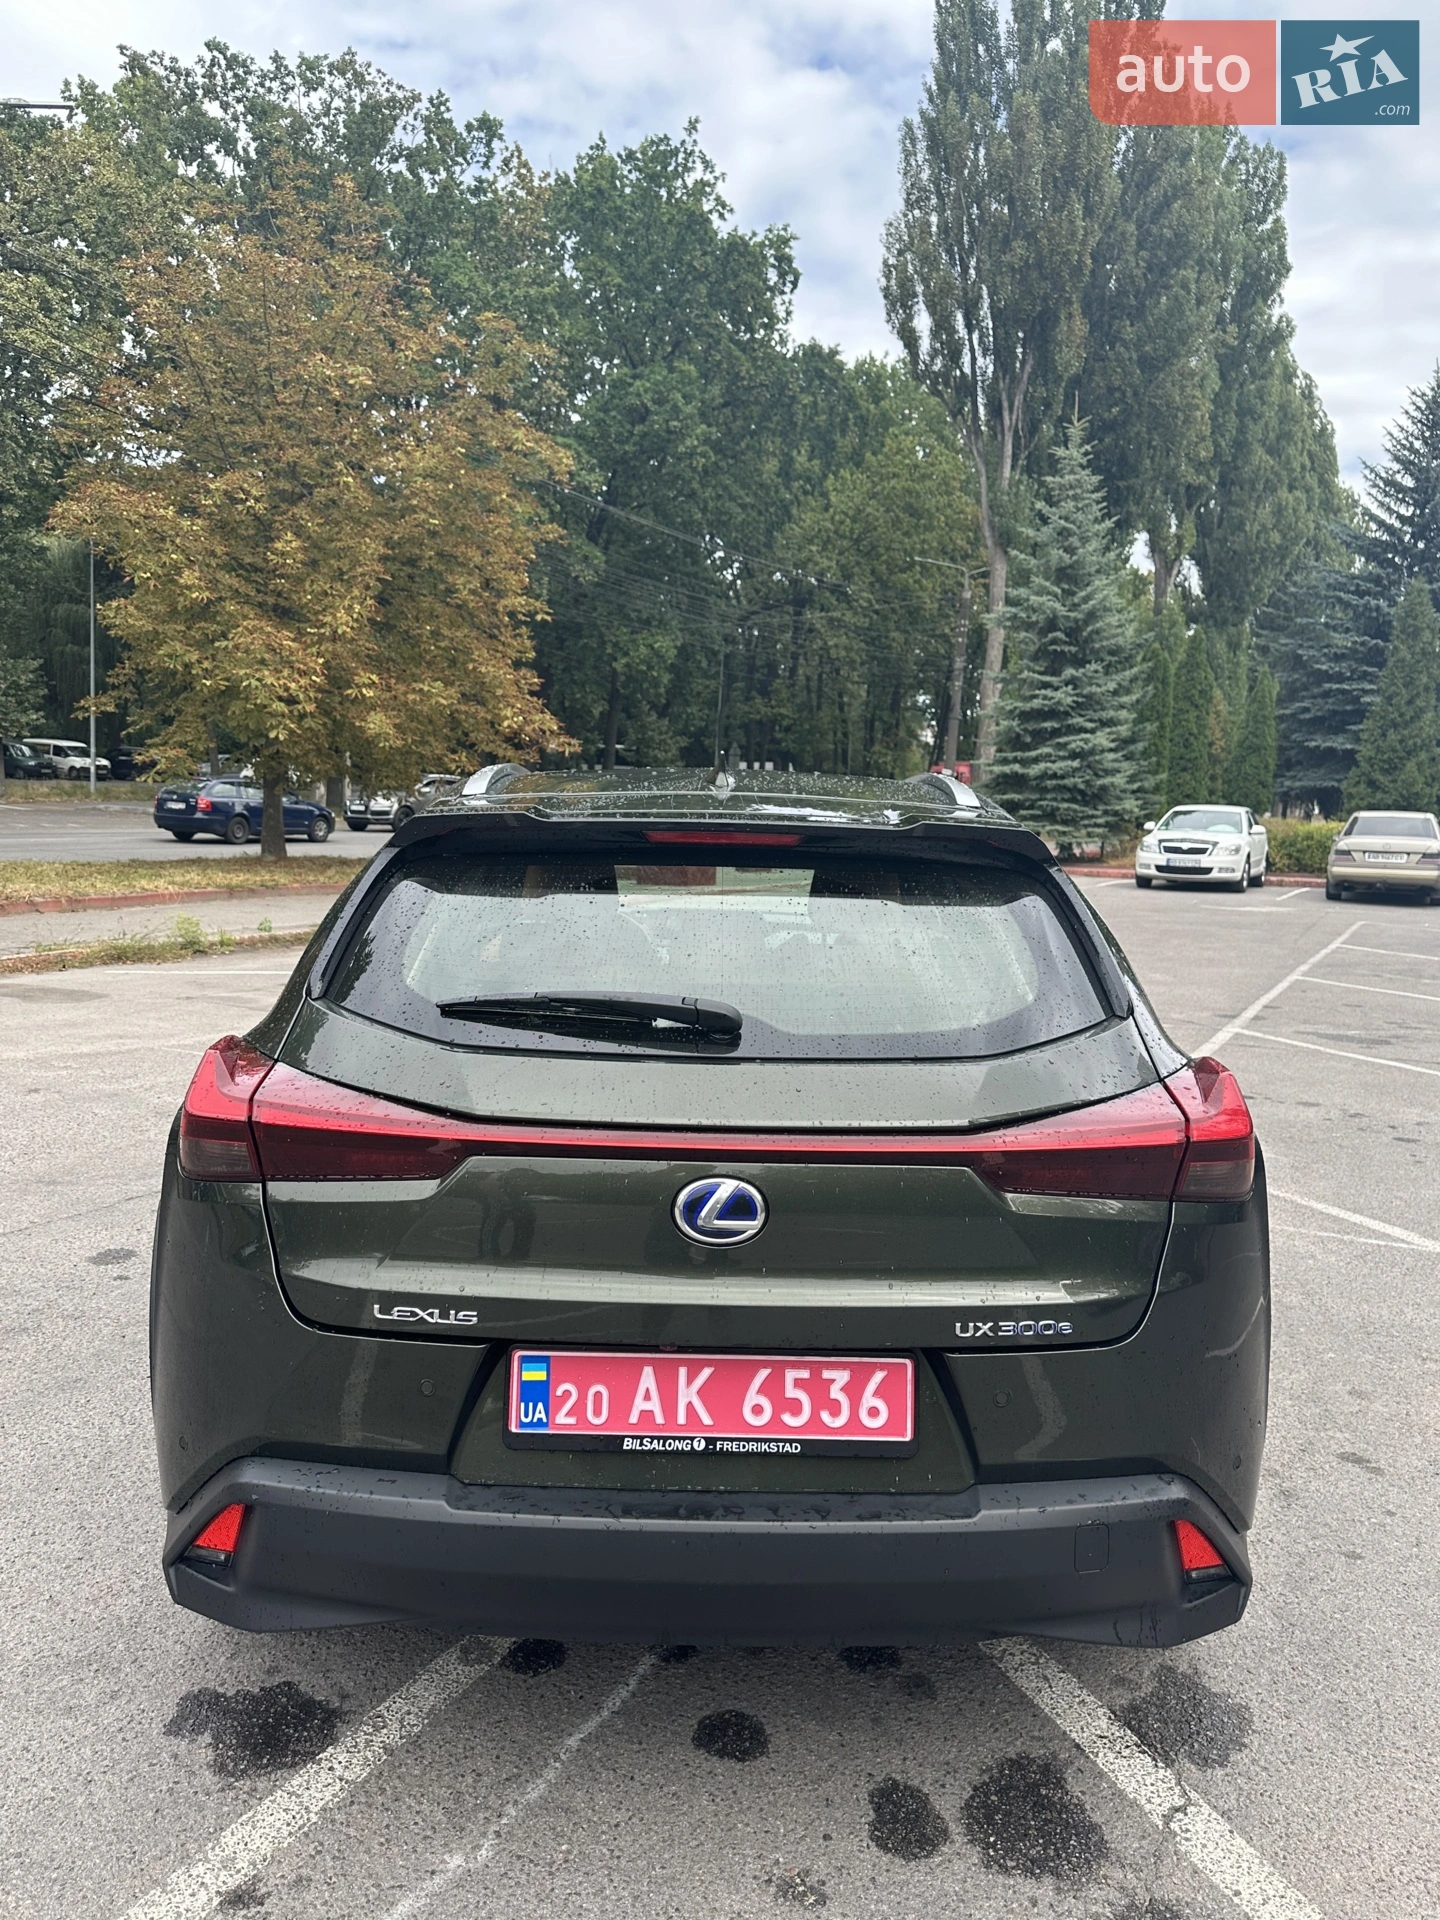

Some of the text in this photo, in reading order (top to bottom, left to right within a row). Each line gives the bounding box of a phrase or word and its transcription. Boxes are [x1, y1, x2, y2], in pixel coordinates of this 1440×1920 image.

[373, 1304, 478, 1325] LEXUS
[955, 1320, 1073, 1337] UX 300e
[554, 1365, 889, 1429] 20 AK 6536
[520, 1402, 547, 1423] UA
[716, 1441, 801, 1453] FREDRIKSTAD
